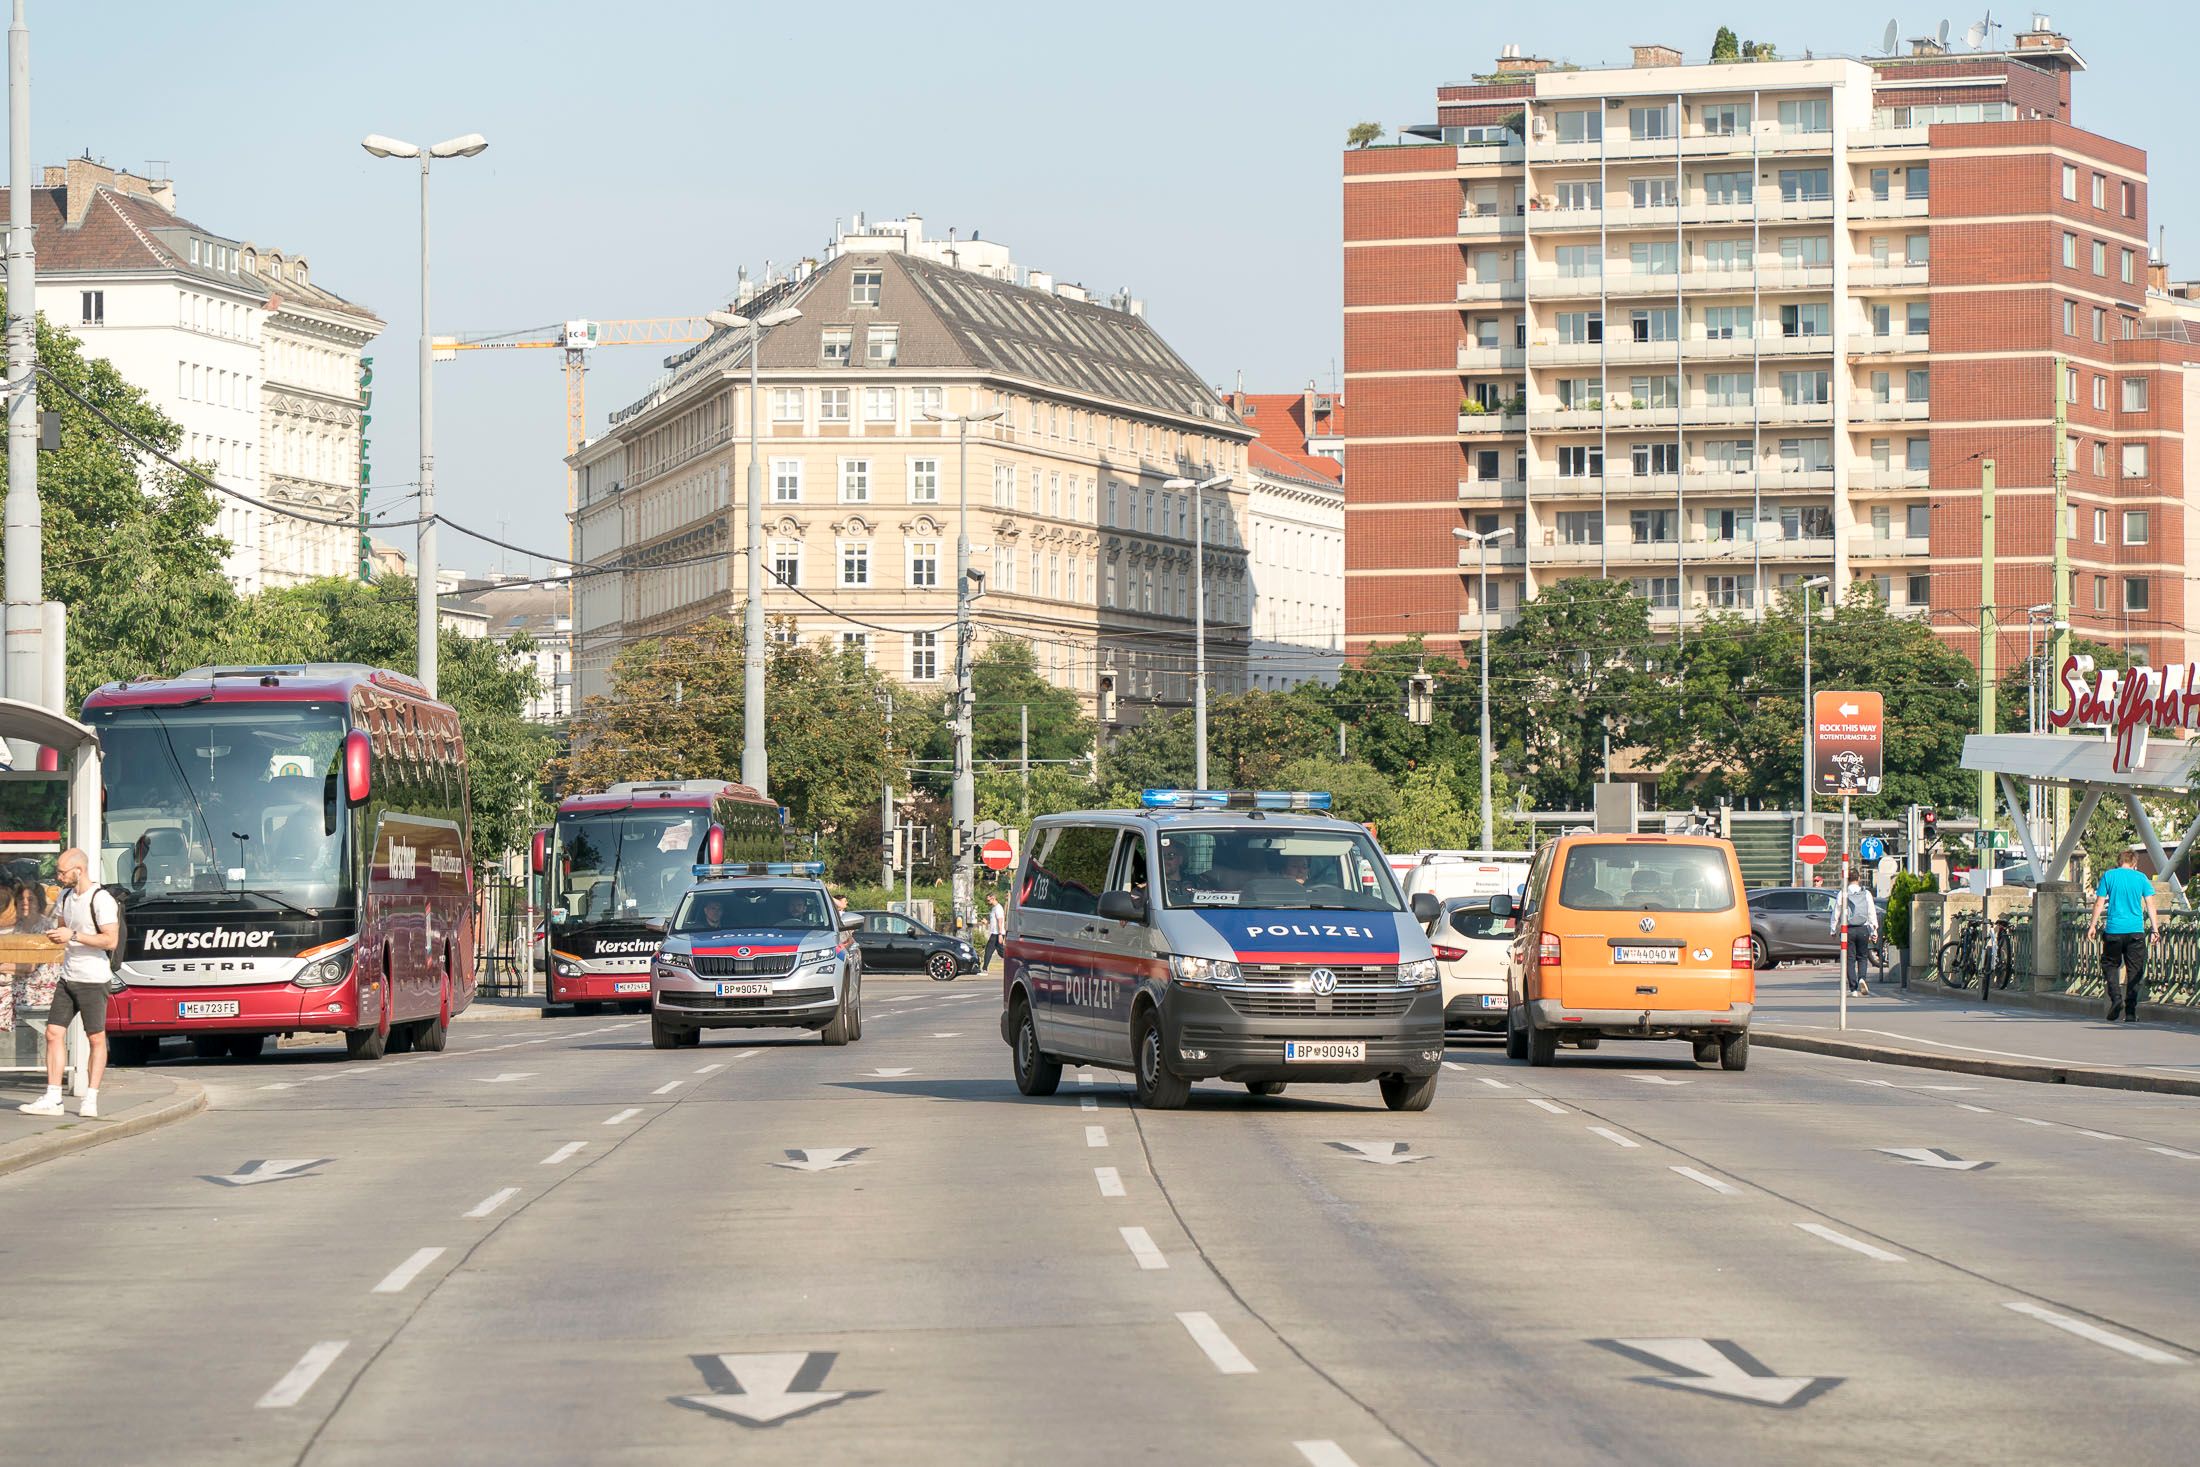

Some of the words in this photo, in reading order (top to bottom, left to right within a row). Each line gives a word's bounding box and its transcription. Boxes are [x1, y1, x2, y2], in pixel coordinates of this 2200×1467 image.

[2050, 655, 2200, 774] Schiffstat
[1819, 724, 1840, 732] ROCK
[1842, 724, 1859, 732] THIS
[1860, 724, 1877, 732] WAY
[1848, 755, 1864, 764] Rock
[388, 835, 417, 880] Kerschner
[1037, 879, 1049, 900] 133
[143, 926, 275, 951] Kerschner
[1246, 925, 1374, 939] POLIZEI
[594, 939, 662, 954] Kerschne
[1698, 948, 1709, 958] A
[161, 962, 255, 972] SETRA
[1066, 975, 1114, 1010] POLIZEI
[1322, 1045, 1360, 1058] 90943
